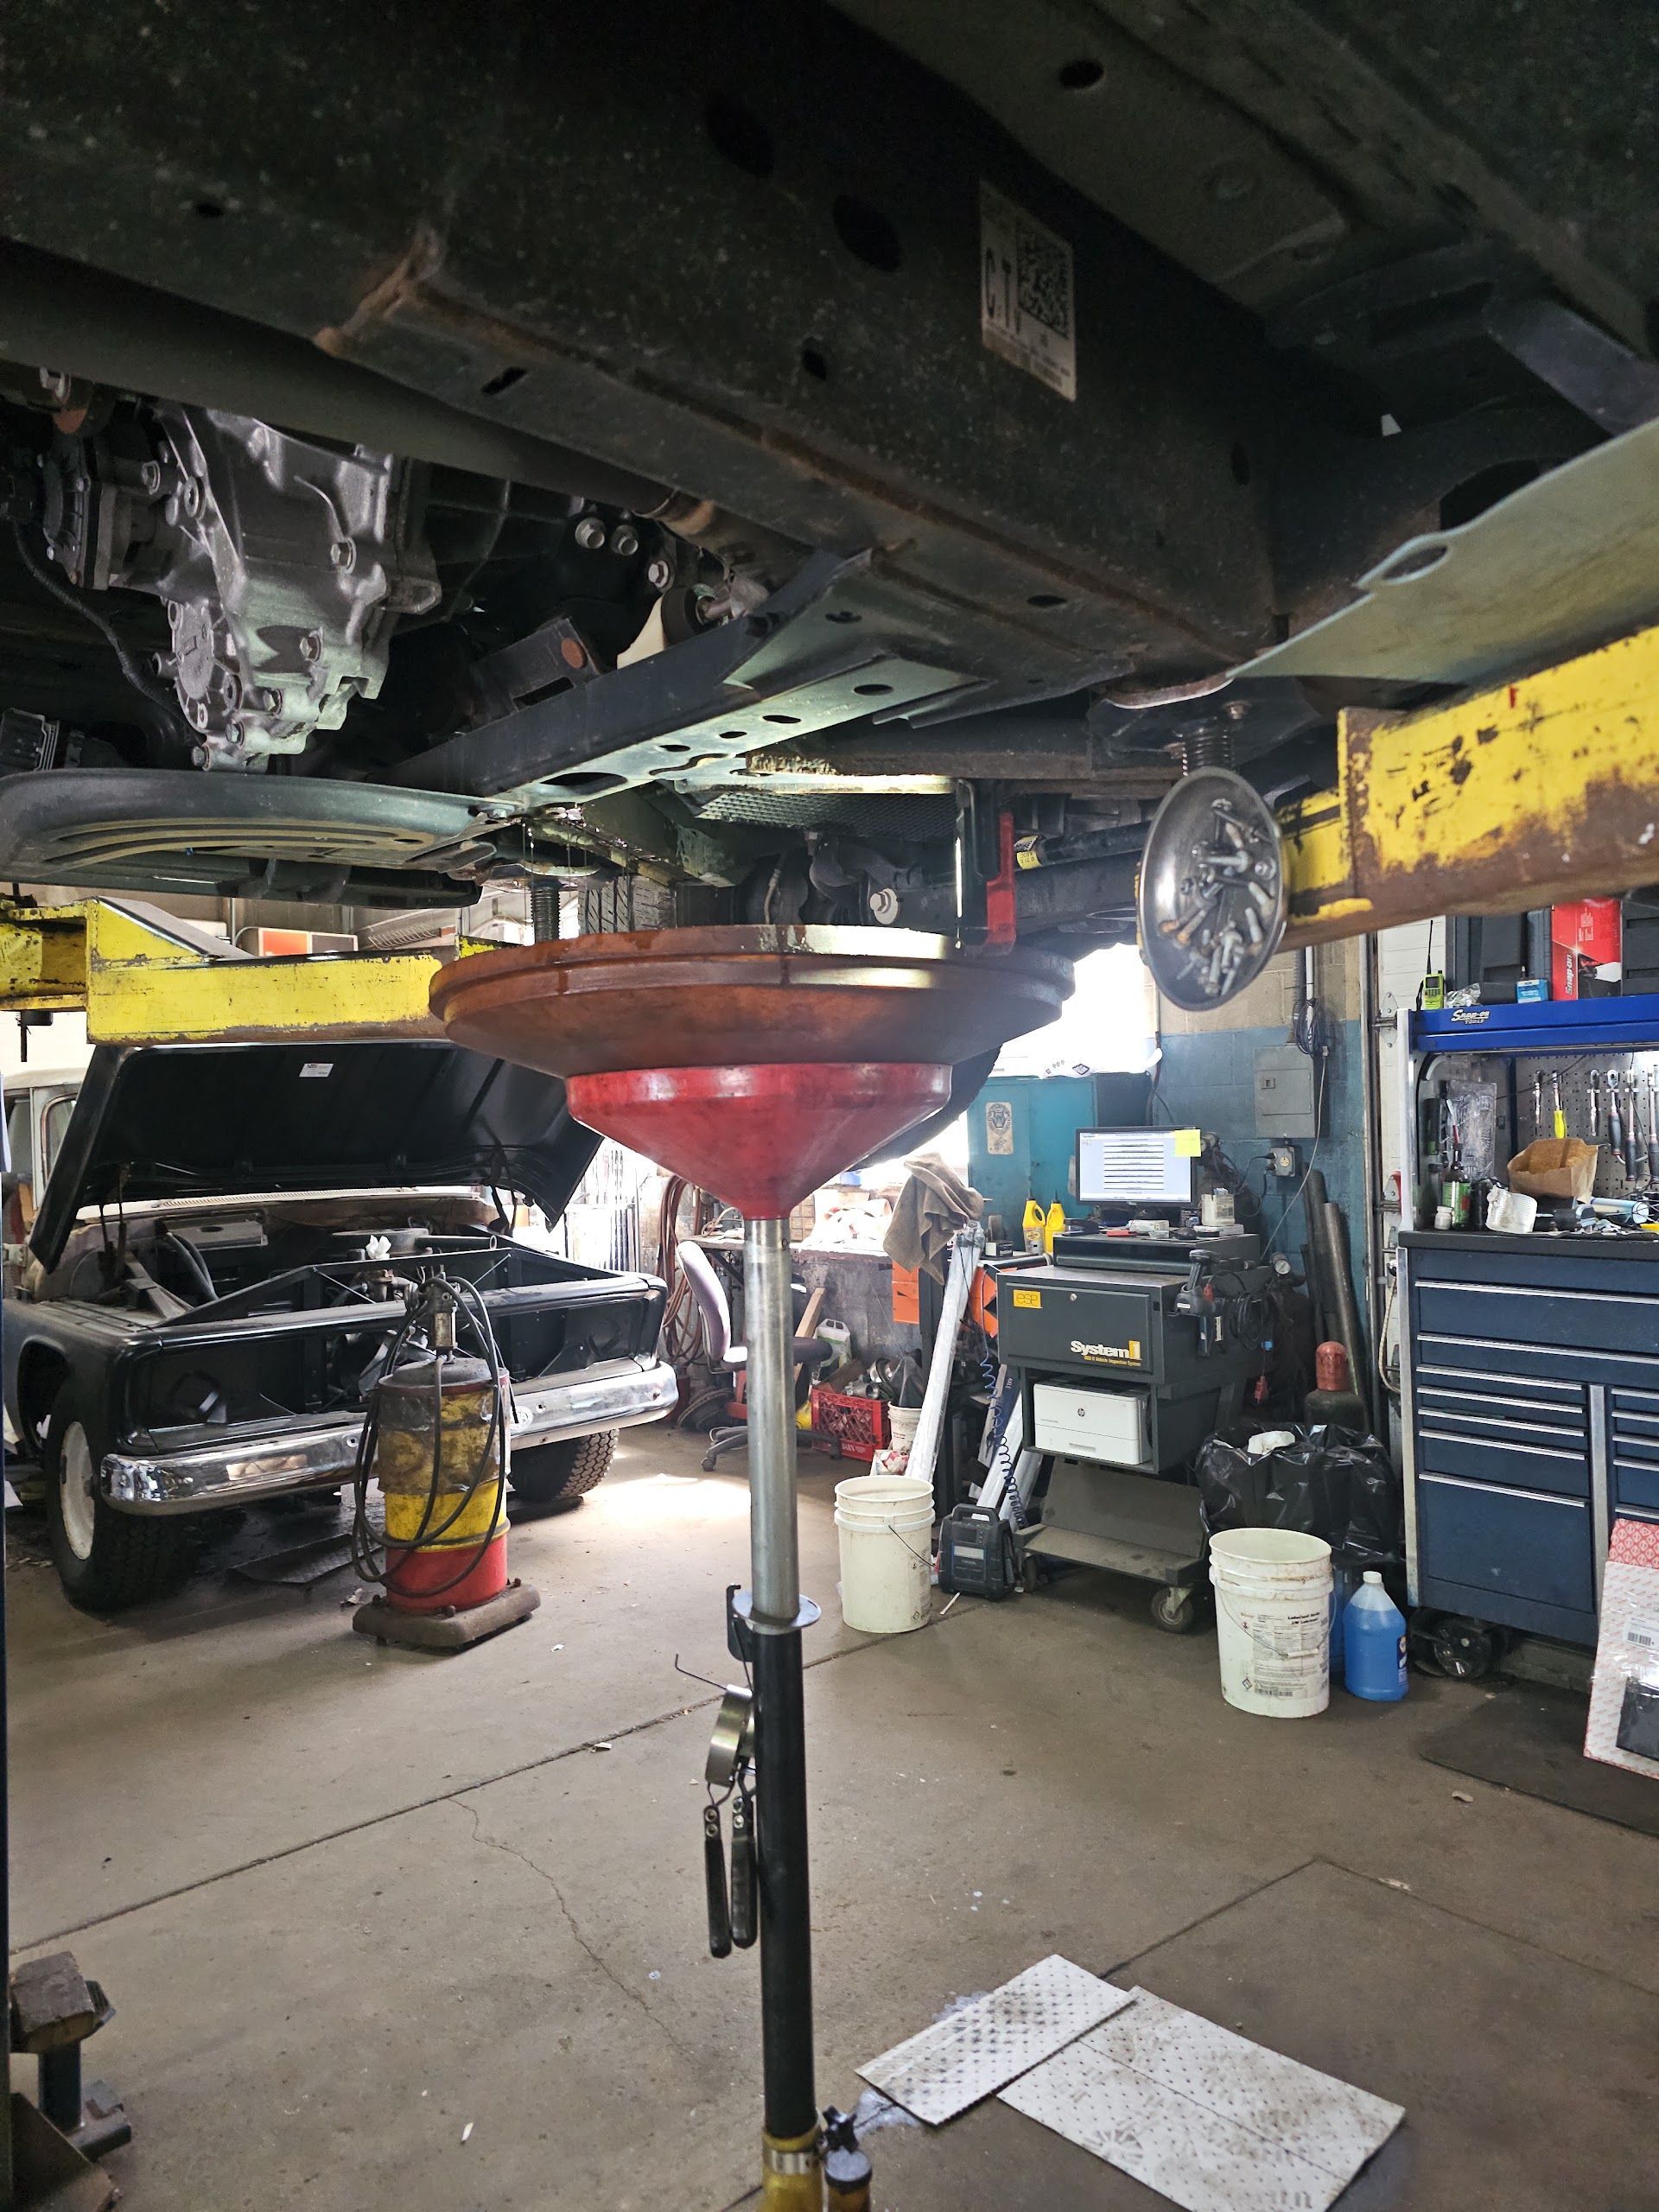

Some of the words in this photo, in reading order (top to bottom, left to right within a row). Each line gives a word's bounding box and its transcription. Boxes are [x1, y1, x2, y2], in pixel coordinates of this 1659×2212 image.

[1565, 953, 1574, 996] Snap-on
[1451, 1008, 1491, 1021] Snap-on
[1016, 1293, 1039, 1305] esp
